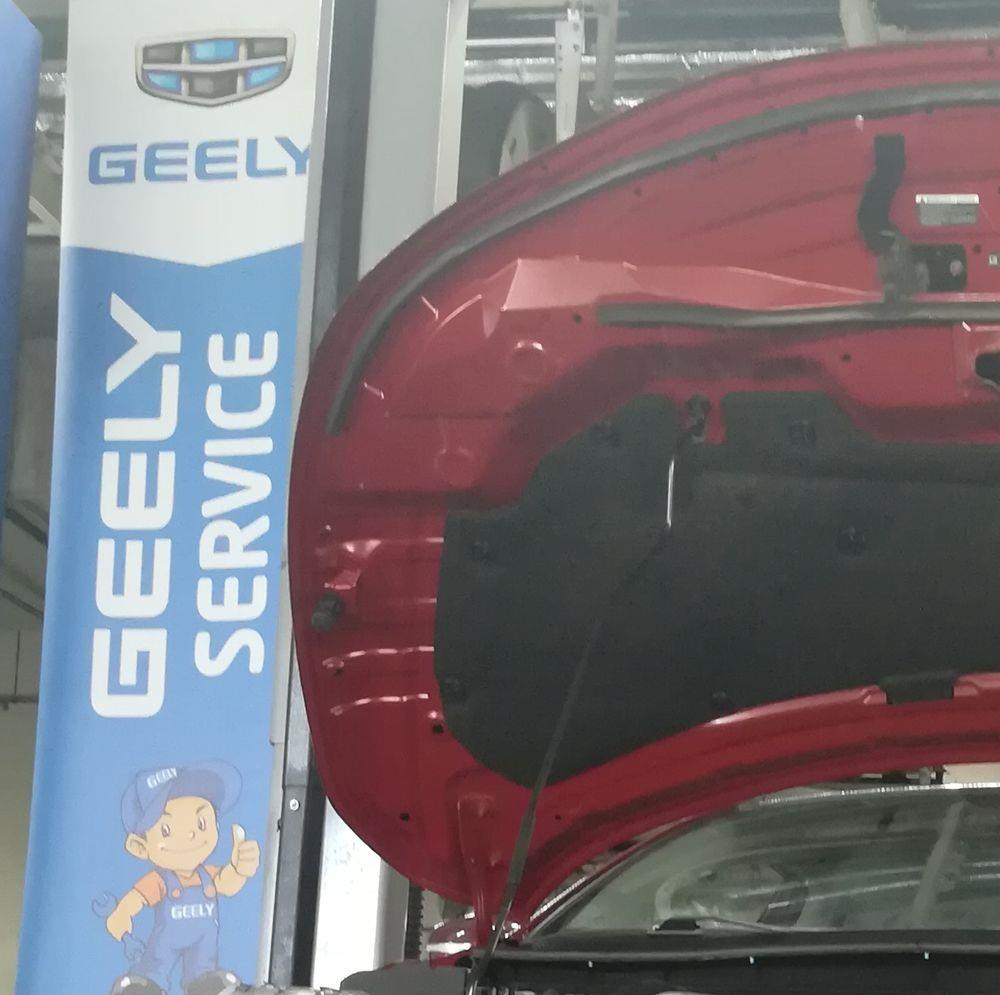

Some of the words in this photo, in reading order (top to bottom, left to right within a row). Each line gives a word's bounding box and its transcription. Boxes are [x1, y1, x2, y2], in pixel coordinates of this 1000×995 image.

[88, 136, 311, 185] GEELY
[91, 293, 181, 718] GEELY
[194, 330, 279, 677] SERVICE
[171, 903, 215, 920] GEELY
